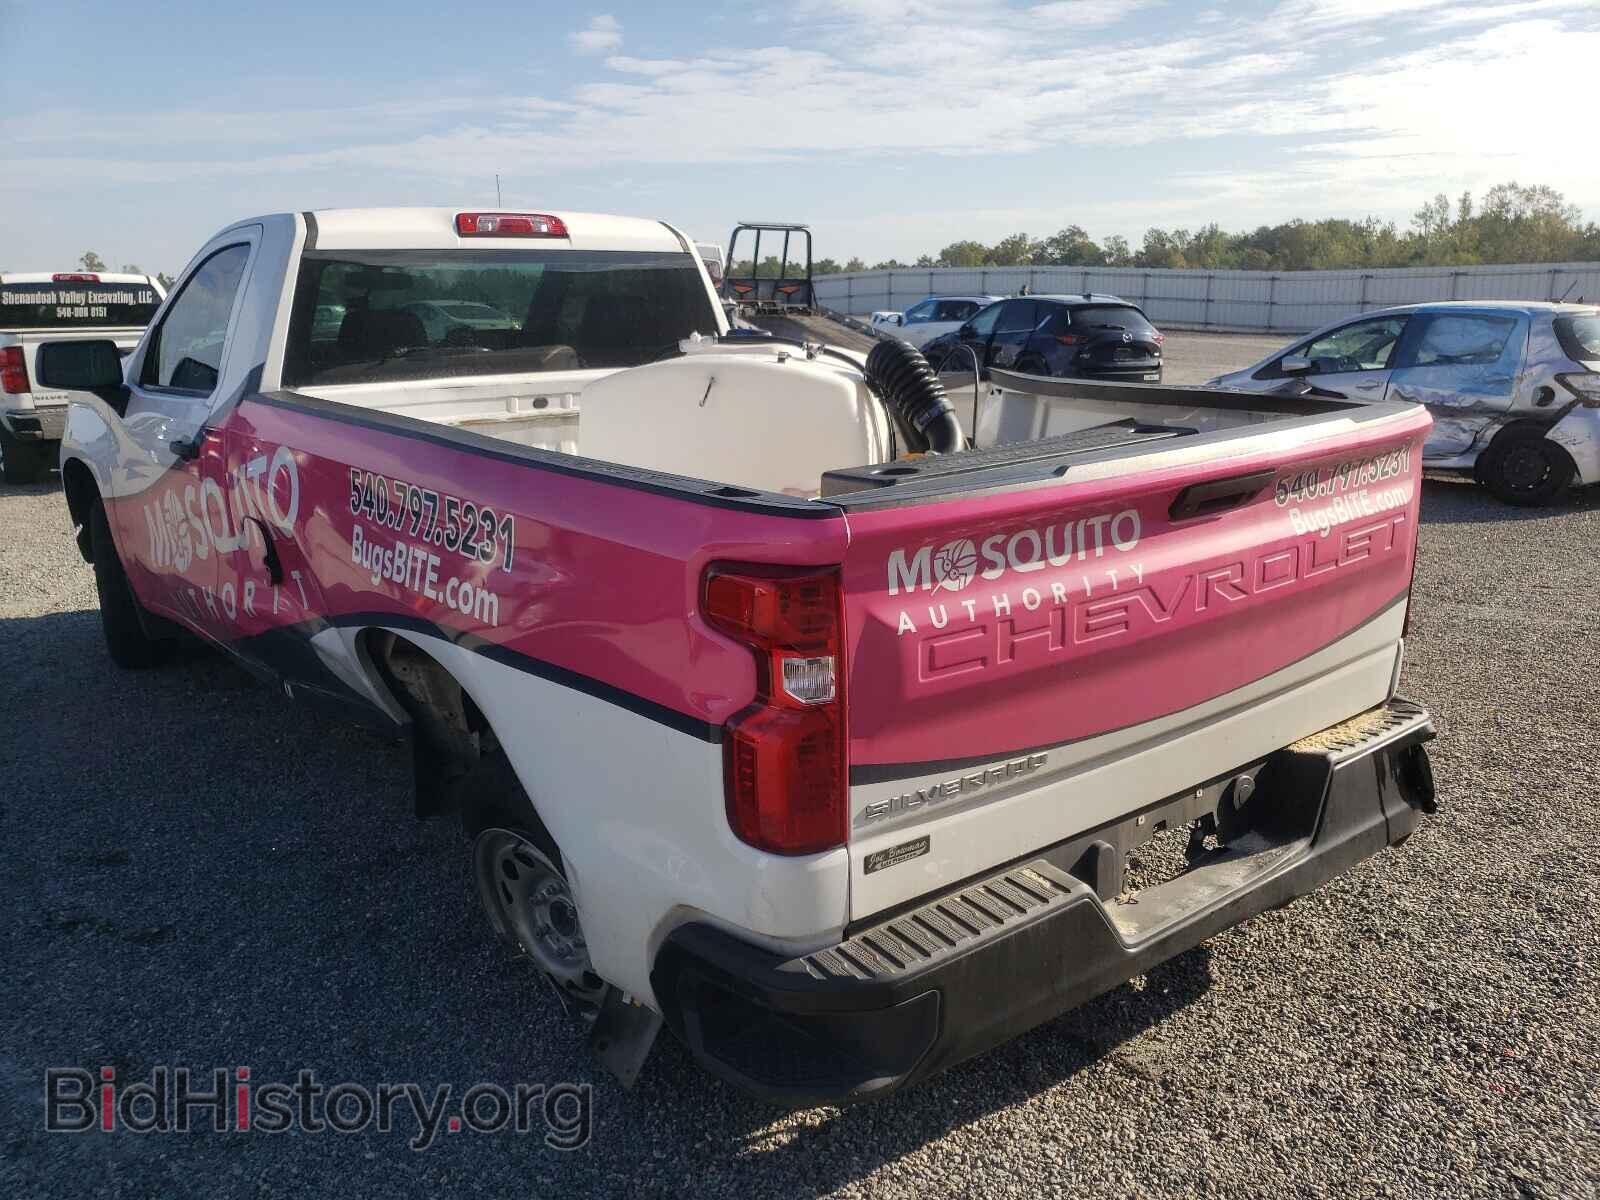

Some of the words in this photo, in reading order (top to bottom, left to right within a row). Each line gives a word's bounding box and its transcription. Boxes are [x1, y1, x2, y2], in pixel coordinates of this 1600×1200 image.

[2, 291, 57, 304] Shenandoah
[59, 291, 86, 306] Valley
[88, 291, 136, 306] Excavating,
[138, 290, 153, 303] LLC
[1274, 446, 1411, 508] 540.797.5231
[1289, 486, 1412, 538] BugsBITE.com
[349, 467, 515, 573] 540.797.5231
[887, 509, 1142, 598] MOSQUITO
[351, 525, 499, 627] BugsBITE.com
[897, 563, 1146, 637] AUTHORITY
[918, 513, 1406, 683] CHEVROLET
[864, 751, 1049, 819] SILVERADO
